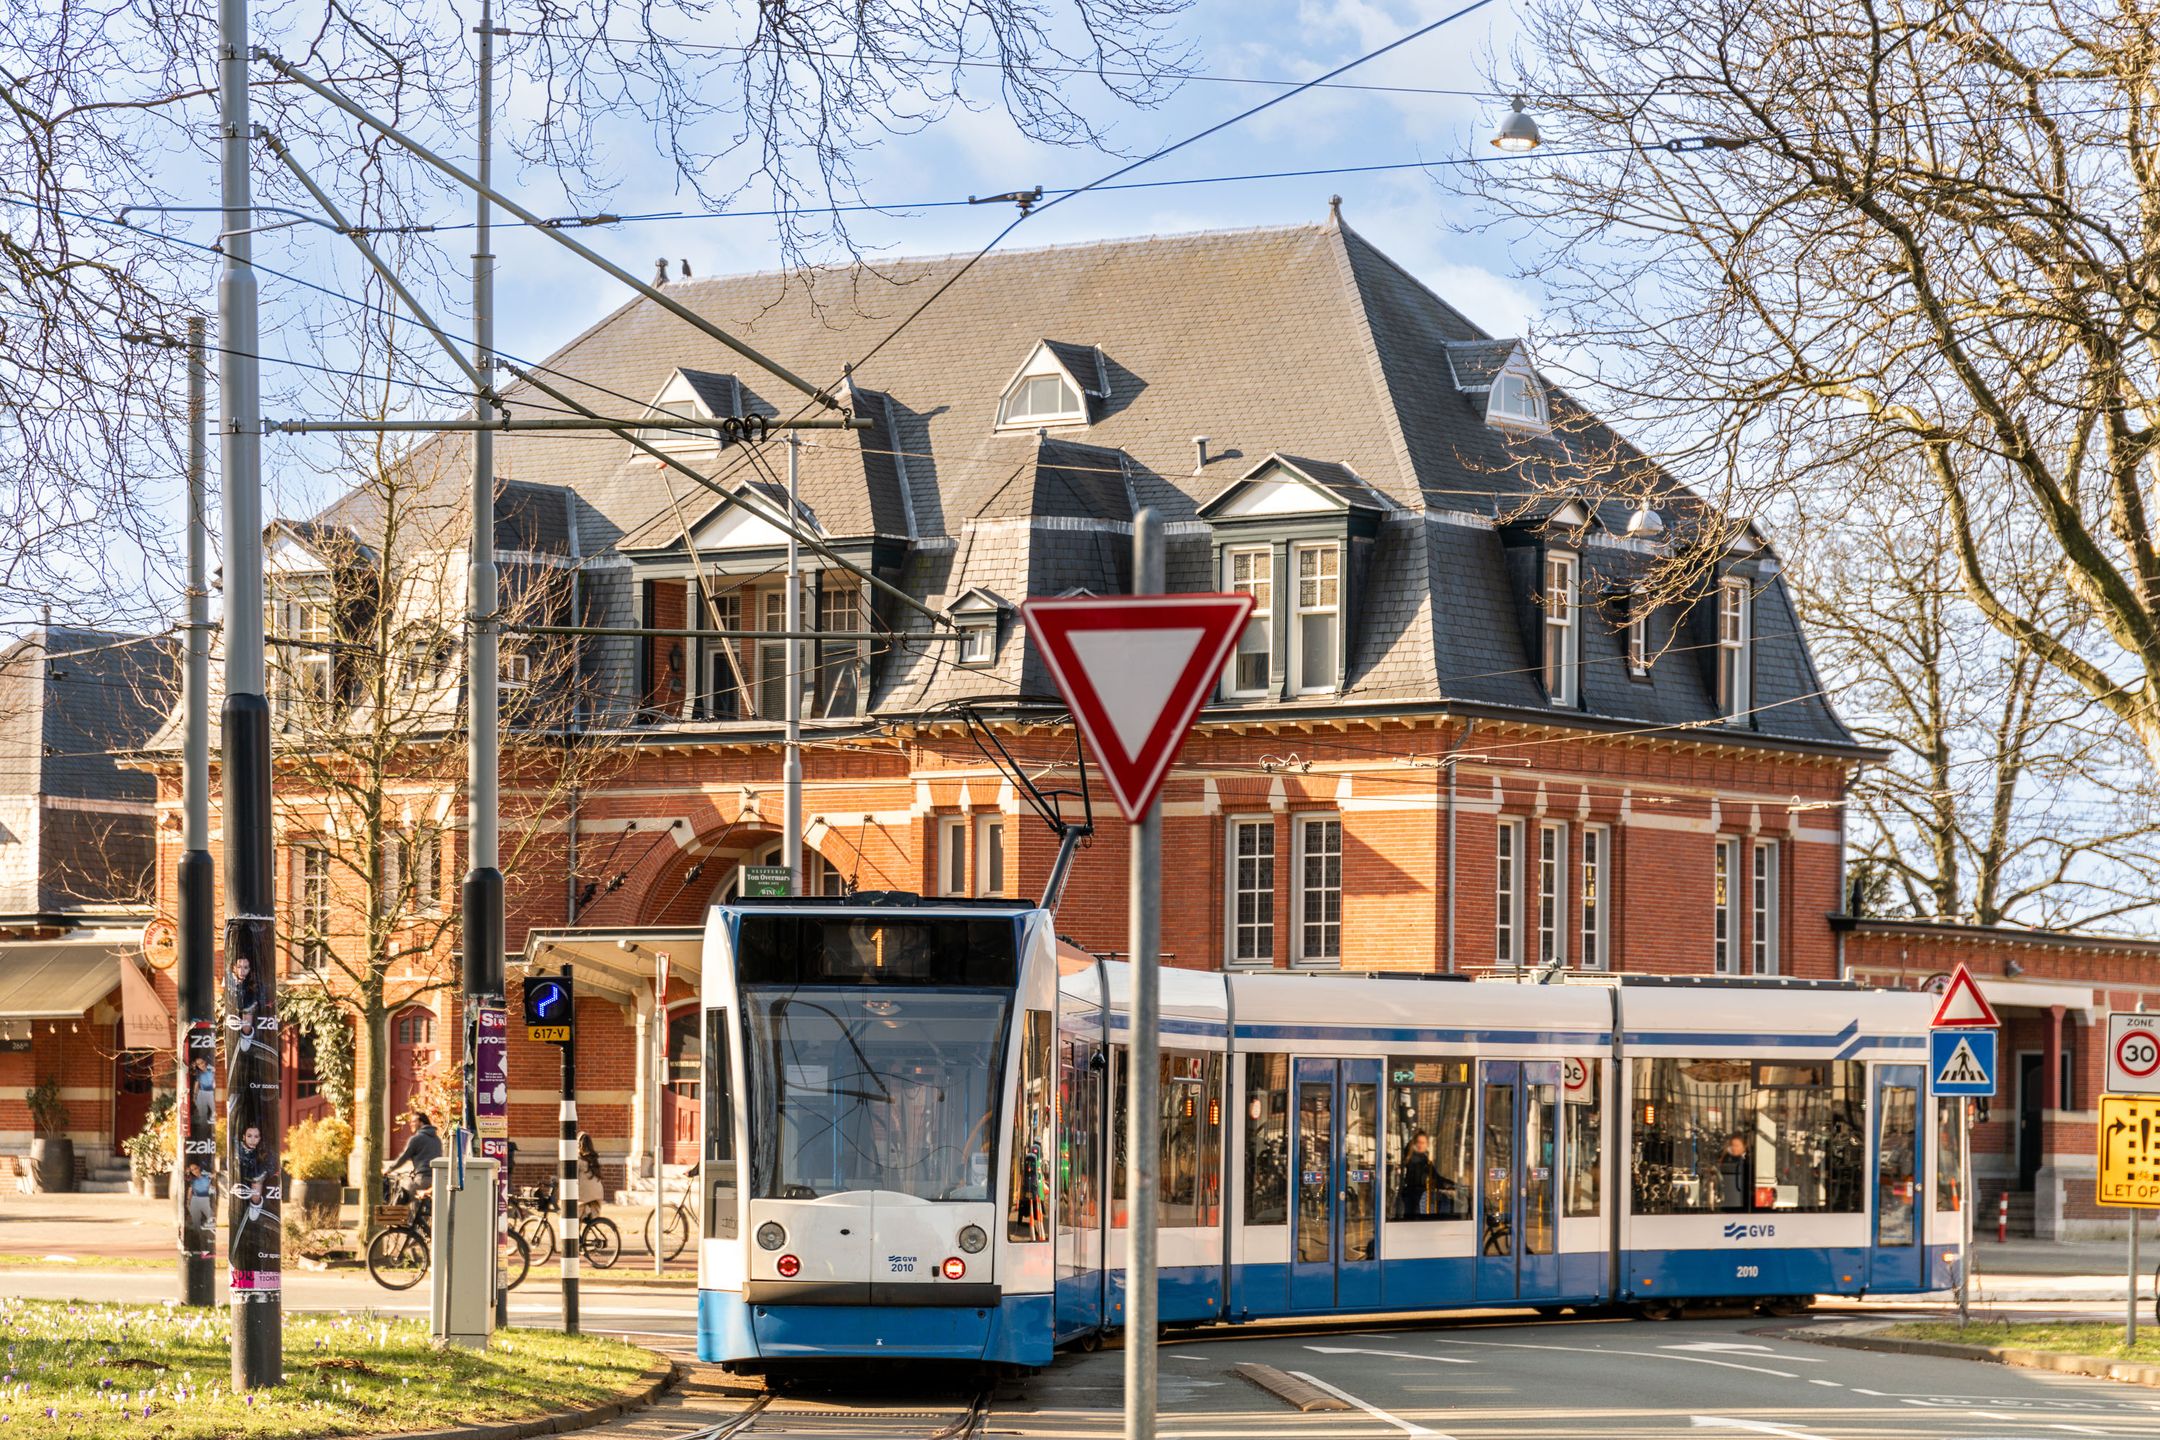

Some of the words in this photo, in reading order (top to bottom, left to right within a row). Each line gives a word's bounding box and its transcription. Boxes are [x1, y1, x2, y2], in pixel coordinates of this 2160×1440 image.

[747, 873, 760, 881] Ton
[760, 873, 790, 881] Overmars
[870, 928, 883, 967] 1
[2127, 1018, 2154, 1027] ZONE
[533, 1028, 564, 1039] 617-V
[2125, 1044, 2155, 1063] 30
[2105, 1183, 2134, 1197] LET
[2137, 1185, 2159, 1198] OP
[1749, 1225, 1776, 1238] GVB
[891, 1263, 914, 1273] 2010
[1736, 1265, 1759, 1278] 2010
